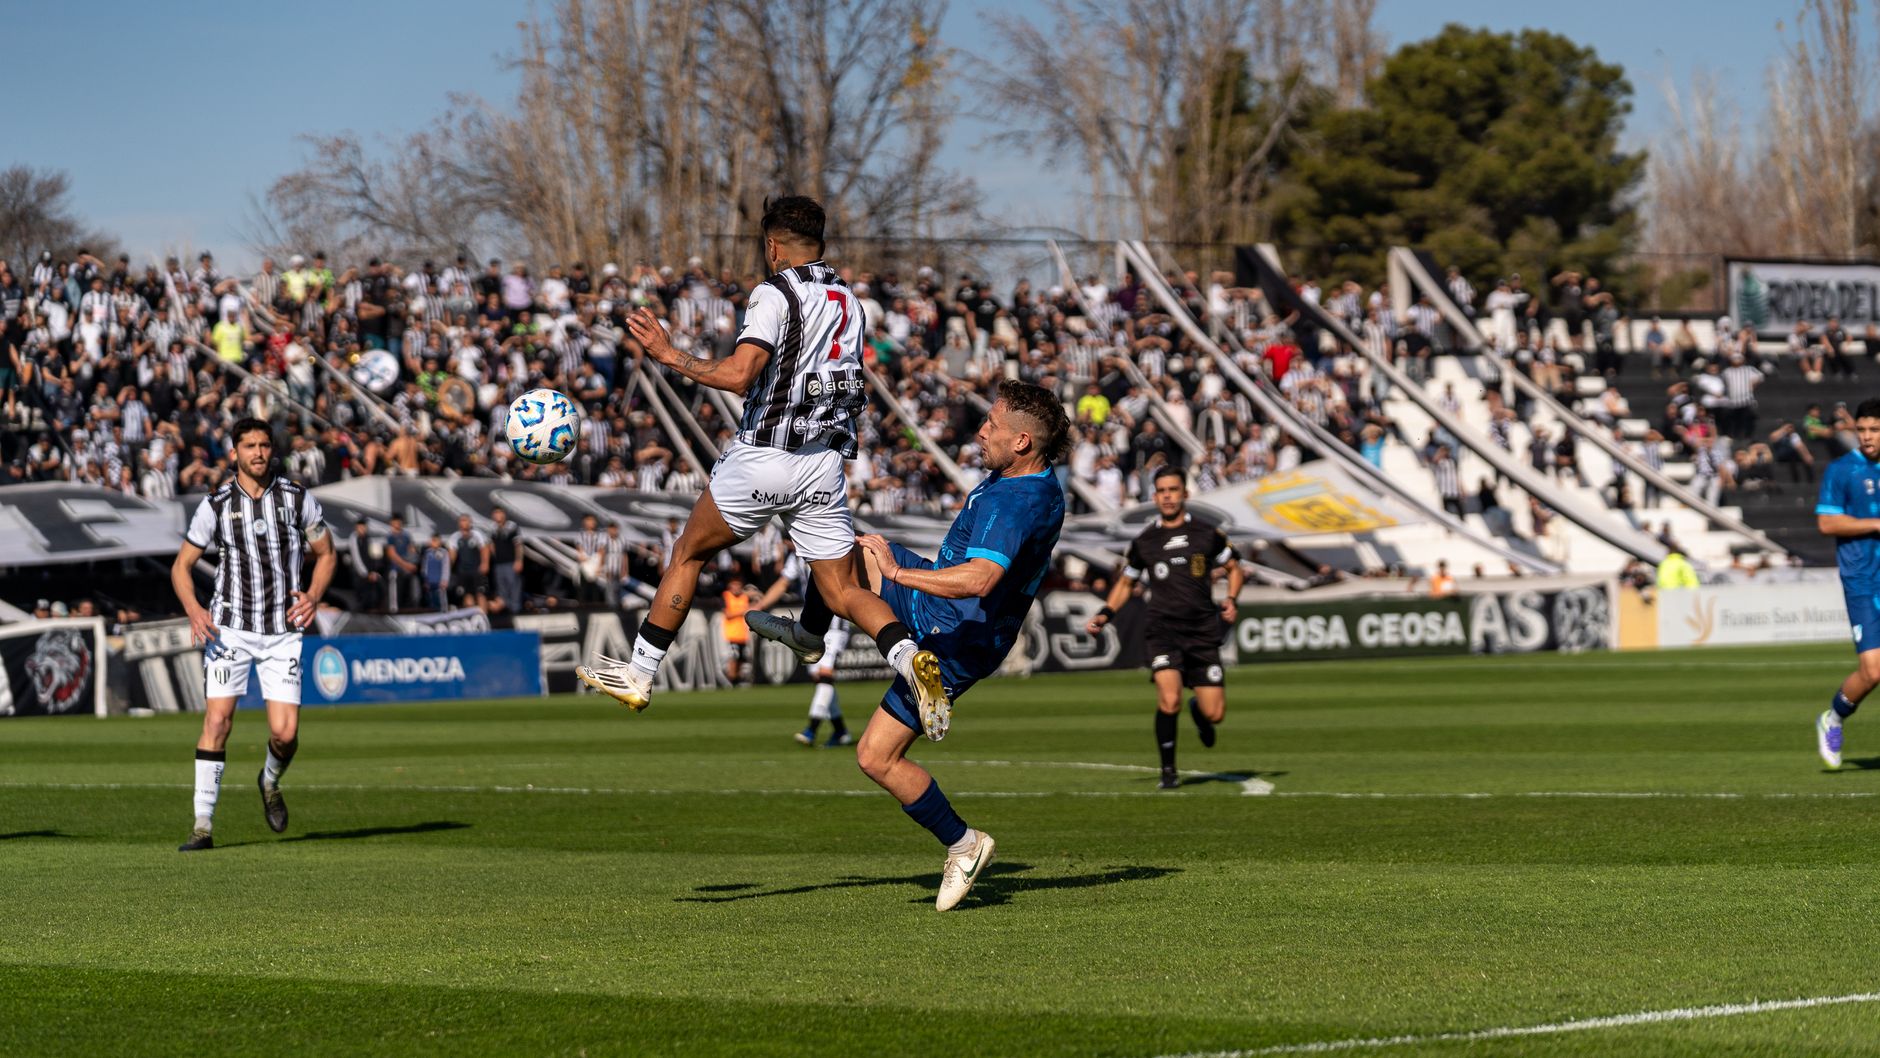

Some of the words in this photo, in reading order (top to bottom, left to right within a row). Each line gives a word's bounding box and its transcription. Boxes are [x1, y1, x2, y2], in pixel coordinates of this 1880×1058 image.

[1767, 279, 1838, 322] RODEO
[826, 289, 849, 360] 7
[1237, 615, 1351, 653] CEOSA
[1357, 610, 1467, 647] CEOSA
[351, 656, 466, 685] MENDOZA
